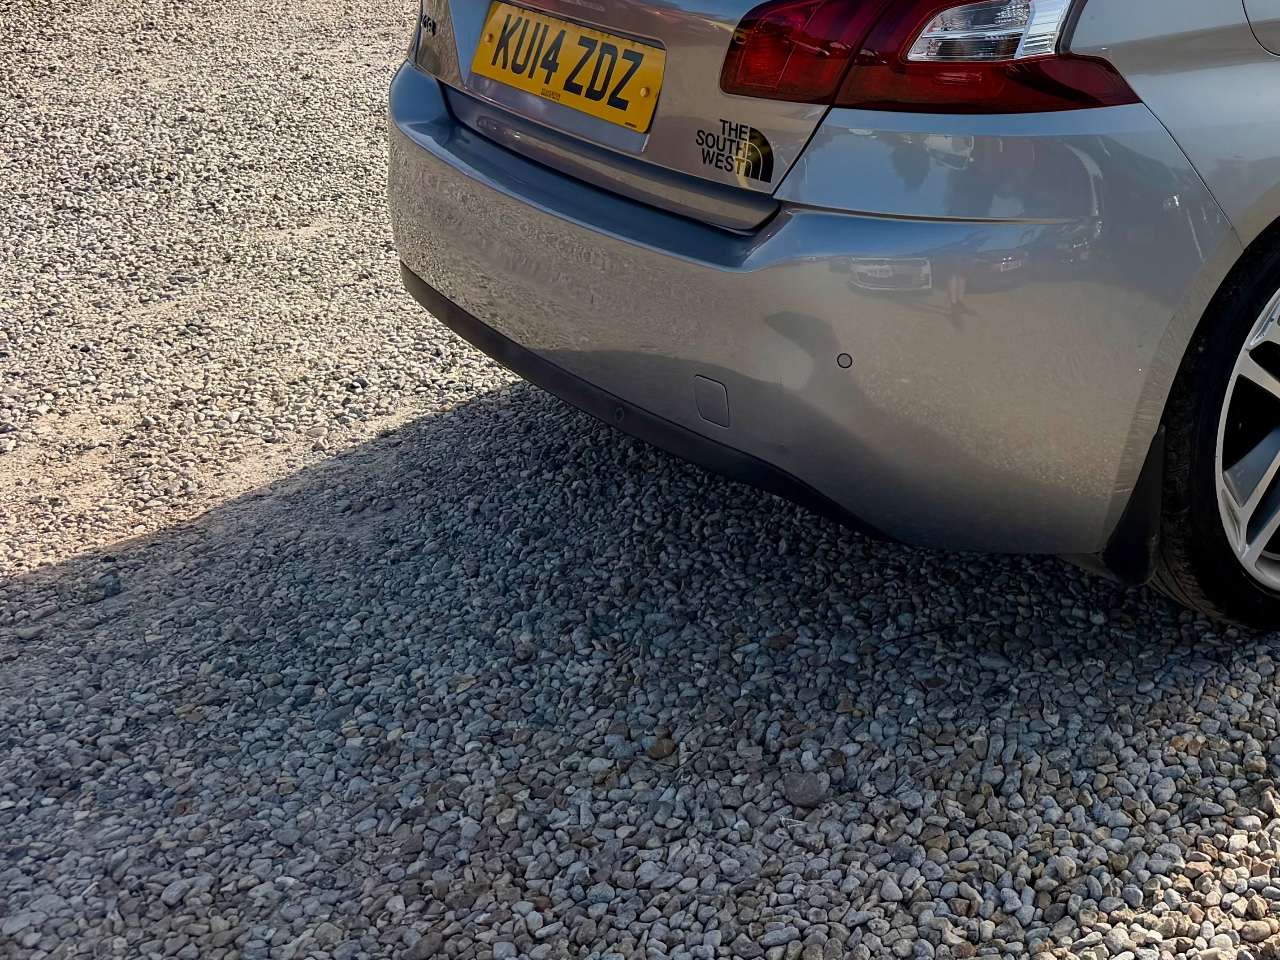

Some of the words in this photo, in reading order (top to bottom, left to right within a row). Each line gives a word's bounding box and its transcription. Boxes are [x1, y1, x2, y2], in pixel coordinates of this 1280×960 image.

[491, 13, 567, 85] KU14
[563, 35, 644, 111] ZDZ
[695, 129, 747, 159] SOUTH
[719, 118, 749, 142] THE
[702, 148, 746, 175] WEST
